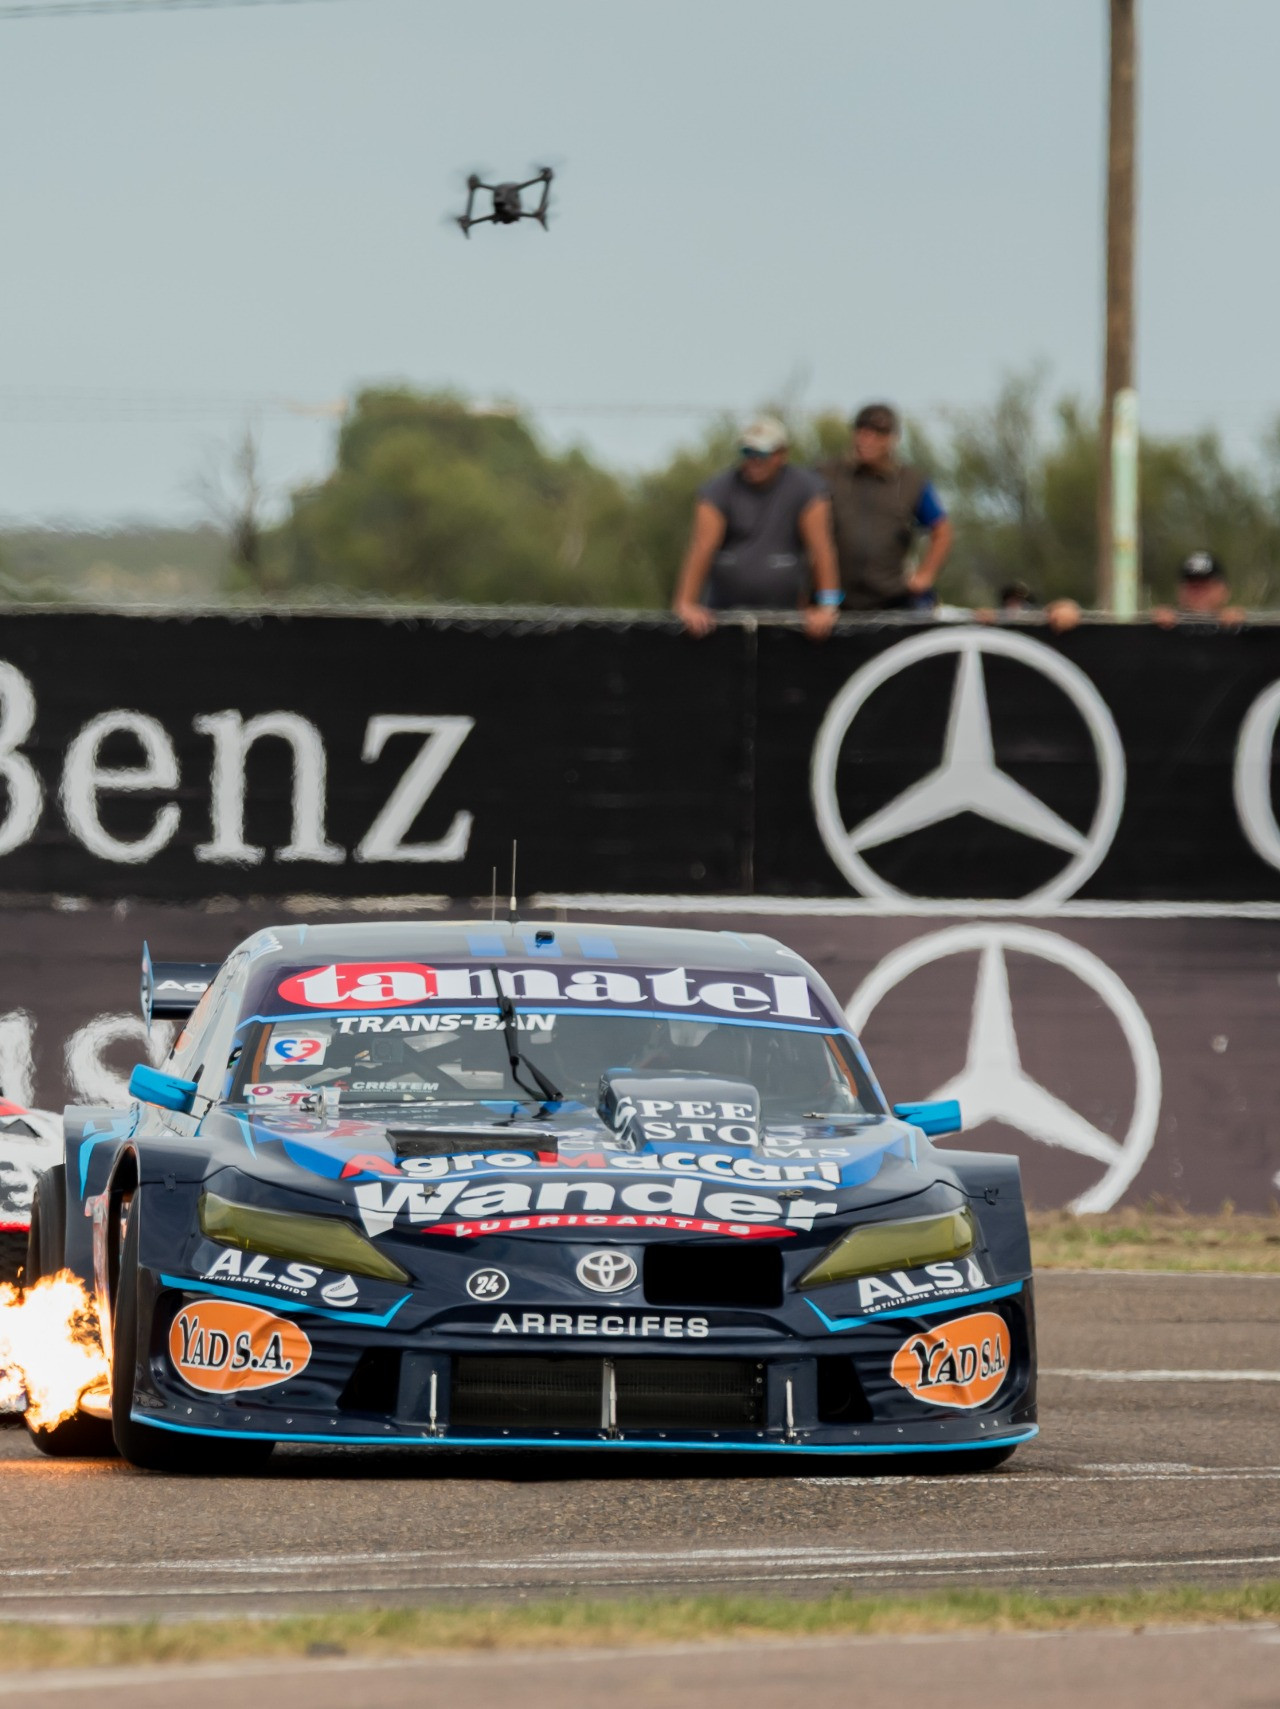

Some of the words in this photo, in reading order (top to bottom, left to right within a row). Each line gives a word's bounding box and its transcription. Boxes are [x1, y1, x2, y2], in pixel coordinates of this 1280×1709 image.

[297, 964, 820, 1020] tamatel
[337, 1014, 556, 1033] TRANS-BAN
[352, 1081, 439, 1091] CRISTEM
[354, 1178, 837, 1238] Wander
[456, 1215, 750, 1238] LUBRICANTES
[206, 1248, 323, 1289] ALS
[475, 1275, 499, 1295] 24
[858, 1261, 964, 1307] ALS
[492, 1312, 709, 1338] ARRECIFES
